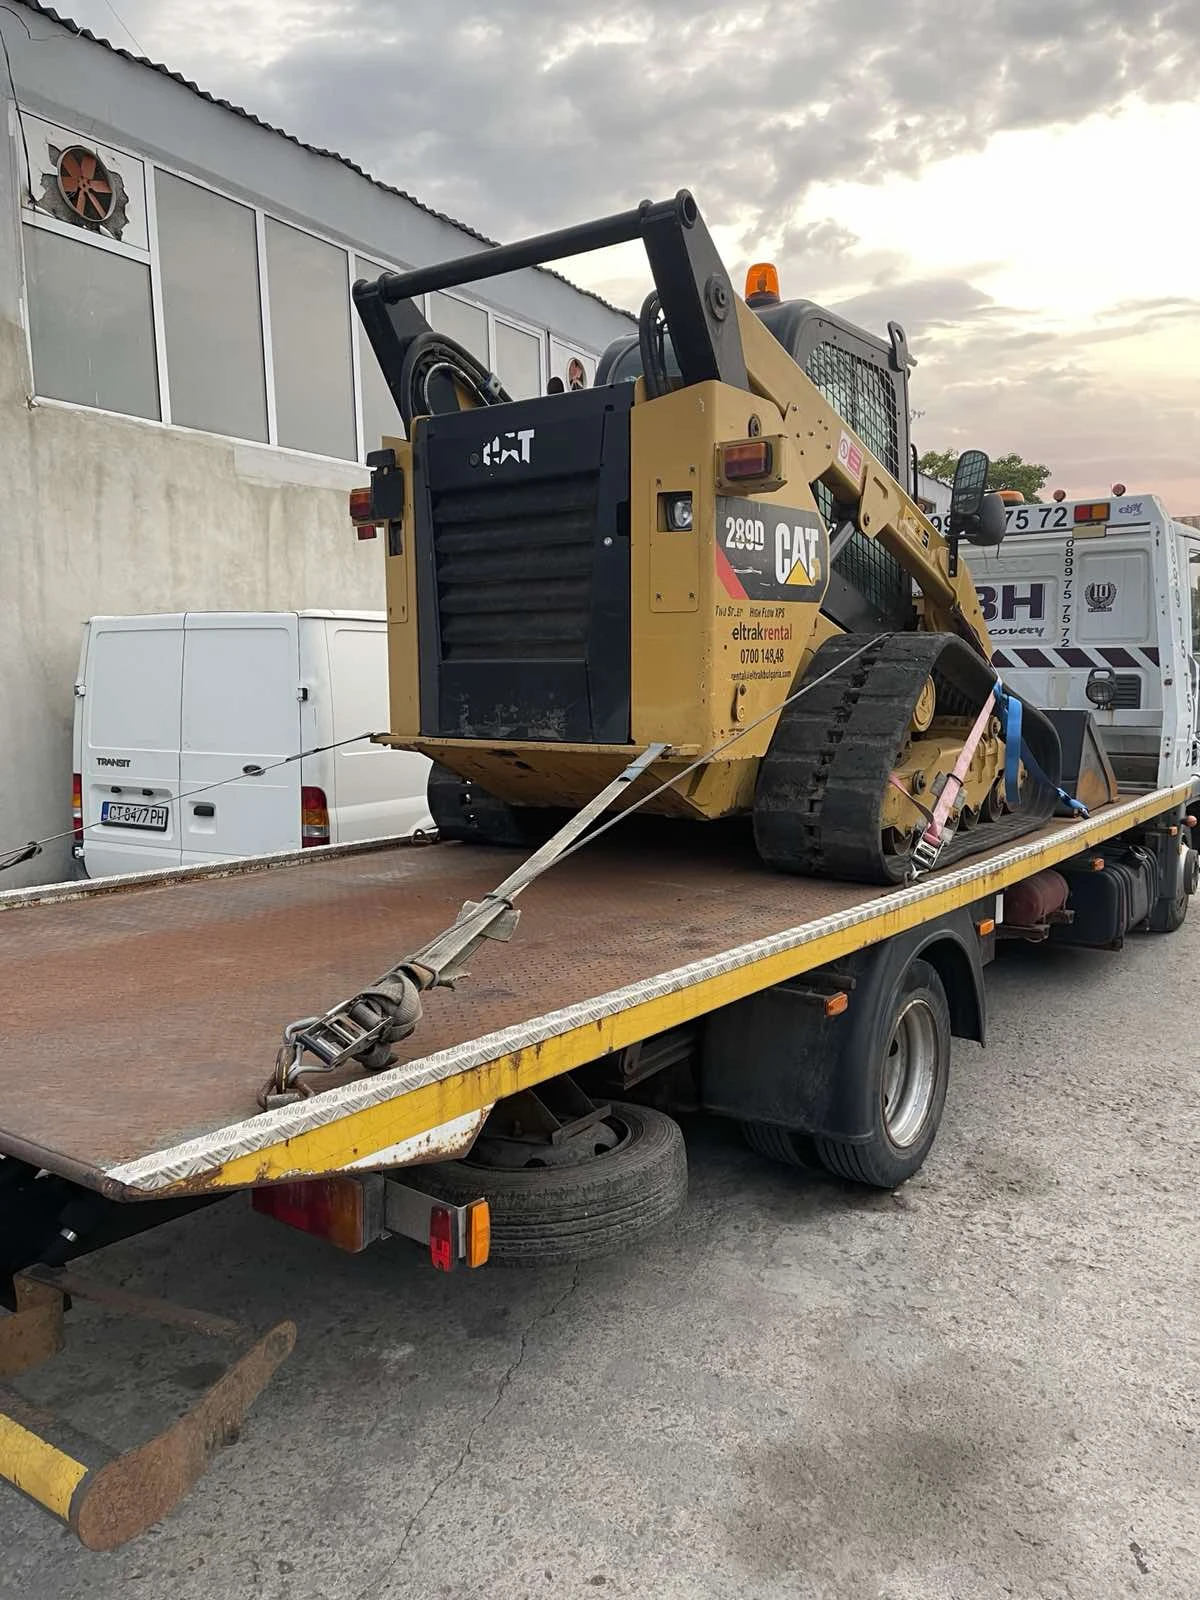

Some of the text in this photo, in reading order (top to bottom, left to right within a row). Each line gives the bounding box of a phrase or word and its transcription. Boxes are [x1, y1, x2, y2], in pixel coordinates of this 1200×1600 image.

[1038, 506, 1068, 528] 72
[725, 517, 765, 551] 289D
[775, 522, 820, 585] CAT
[1061, 539, 1075, 648] 0899 75 75 72
[732, 621, 793, 641] eltrakrental
[740, 648, 759, 665] 0700
[96, 757, 131, 768] TRANSIT
[110, 805, 165, 825] CT 8477 PH
